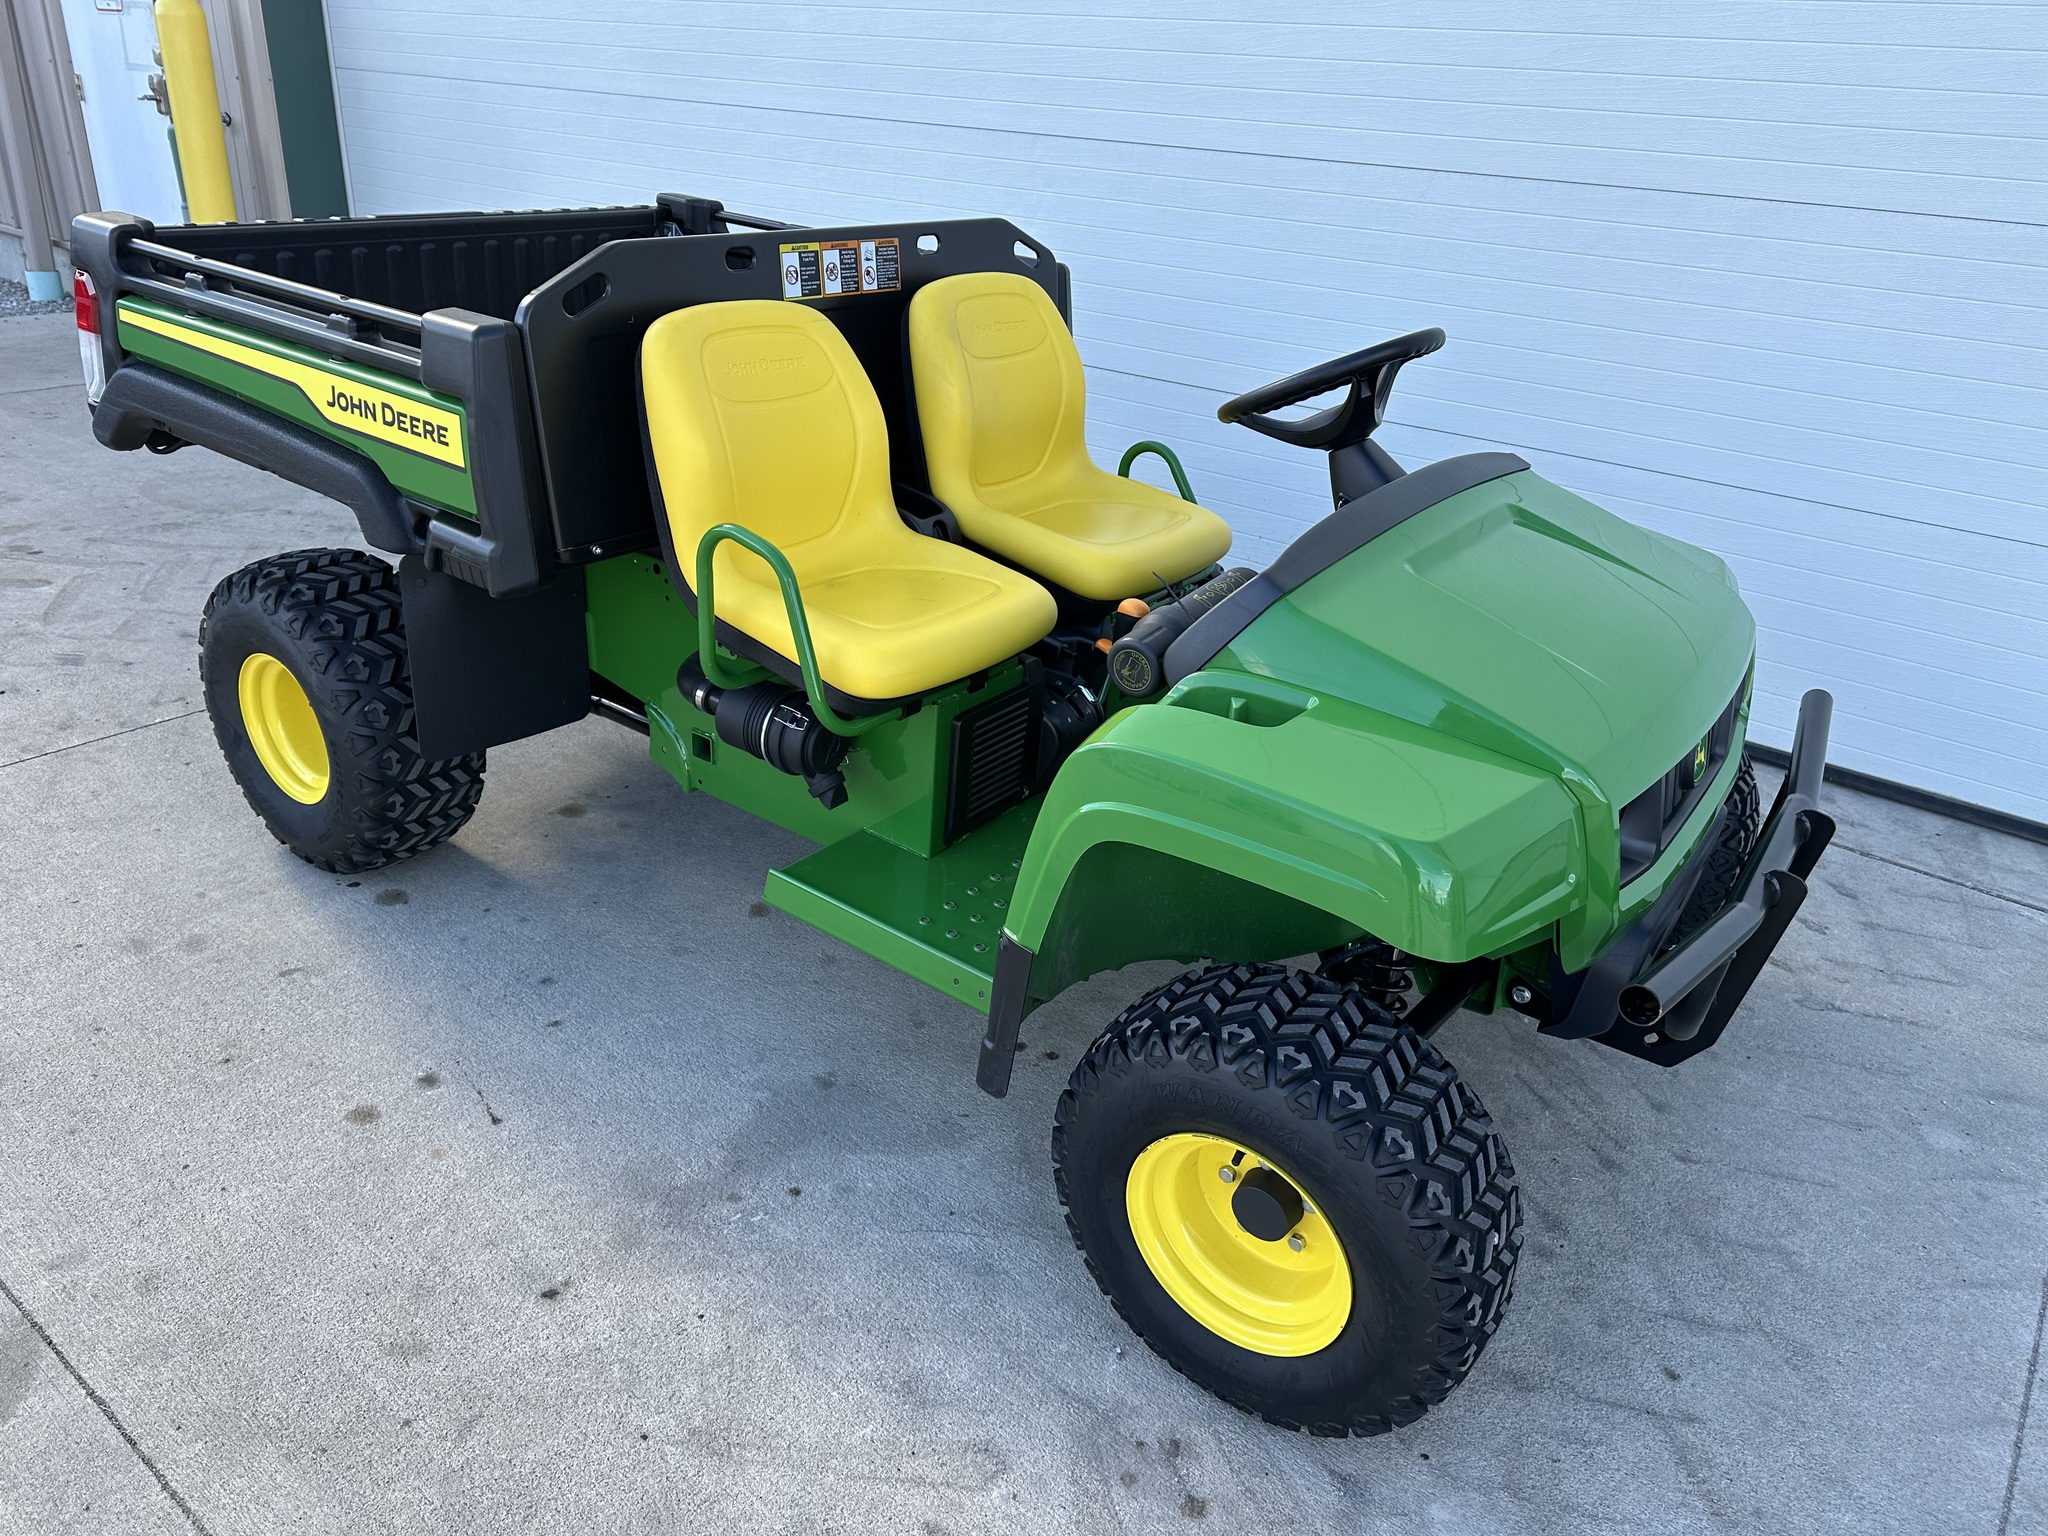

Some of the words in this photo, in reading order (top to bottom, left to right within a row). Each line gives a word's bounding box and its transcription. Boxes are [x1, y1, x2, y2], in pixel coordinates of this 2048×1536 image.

[726, 361, 760, 376] JOHN
[760, 356, 807, 372] DEERE
[326, 385, 377, 422] JOHN
[381, 401, 450, 448] DEERE
[1152, 1082, 1304, 1153] WANDA
